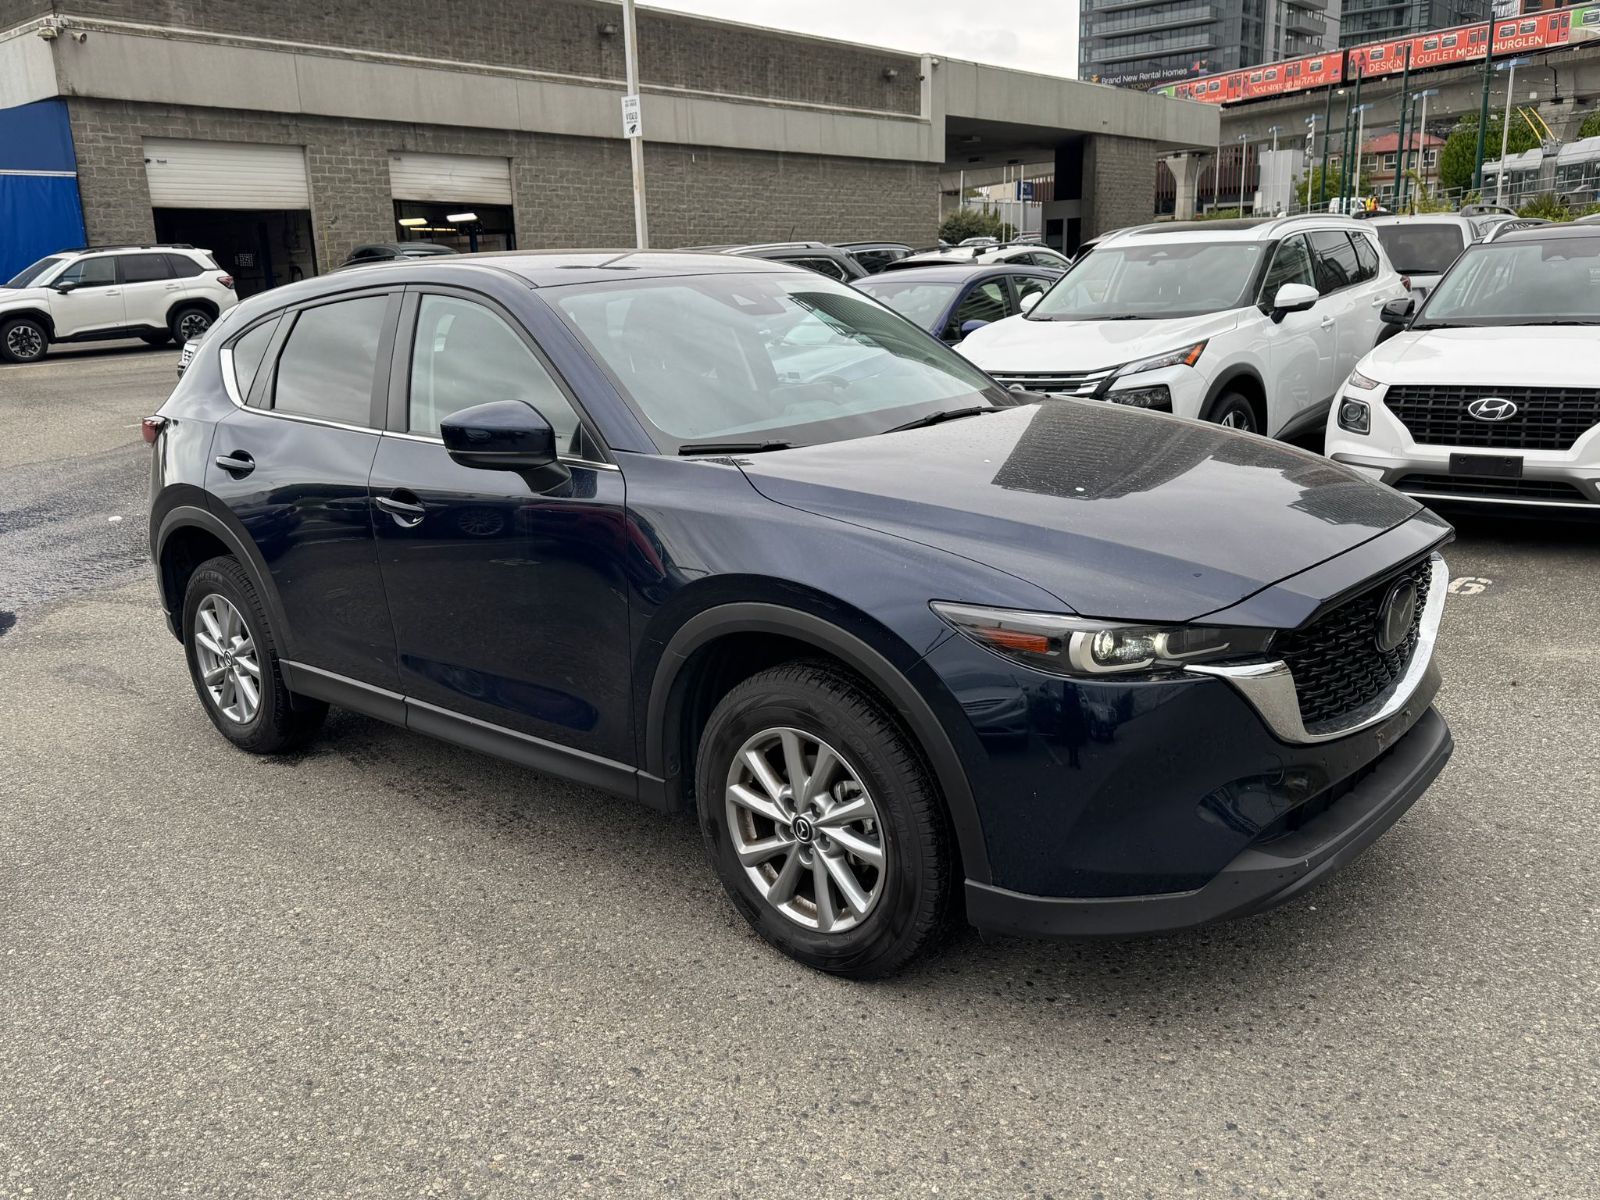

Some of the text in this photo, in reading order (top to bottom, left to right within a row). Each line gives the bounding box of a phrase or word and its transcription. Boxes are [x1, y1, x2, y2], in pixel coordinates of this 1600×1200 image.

[1369, 35, 1544, 72] DESIGNR OUTLET MCARHURGLEN
[1102, 68, 1187, 85] Brand New Rental Homes
[1252, 85, 1266, 94] Next
[1301, 76, 1314, 85] 70%
[1315, 73, 1326, 84] off
